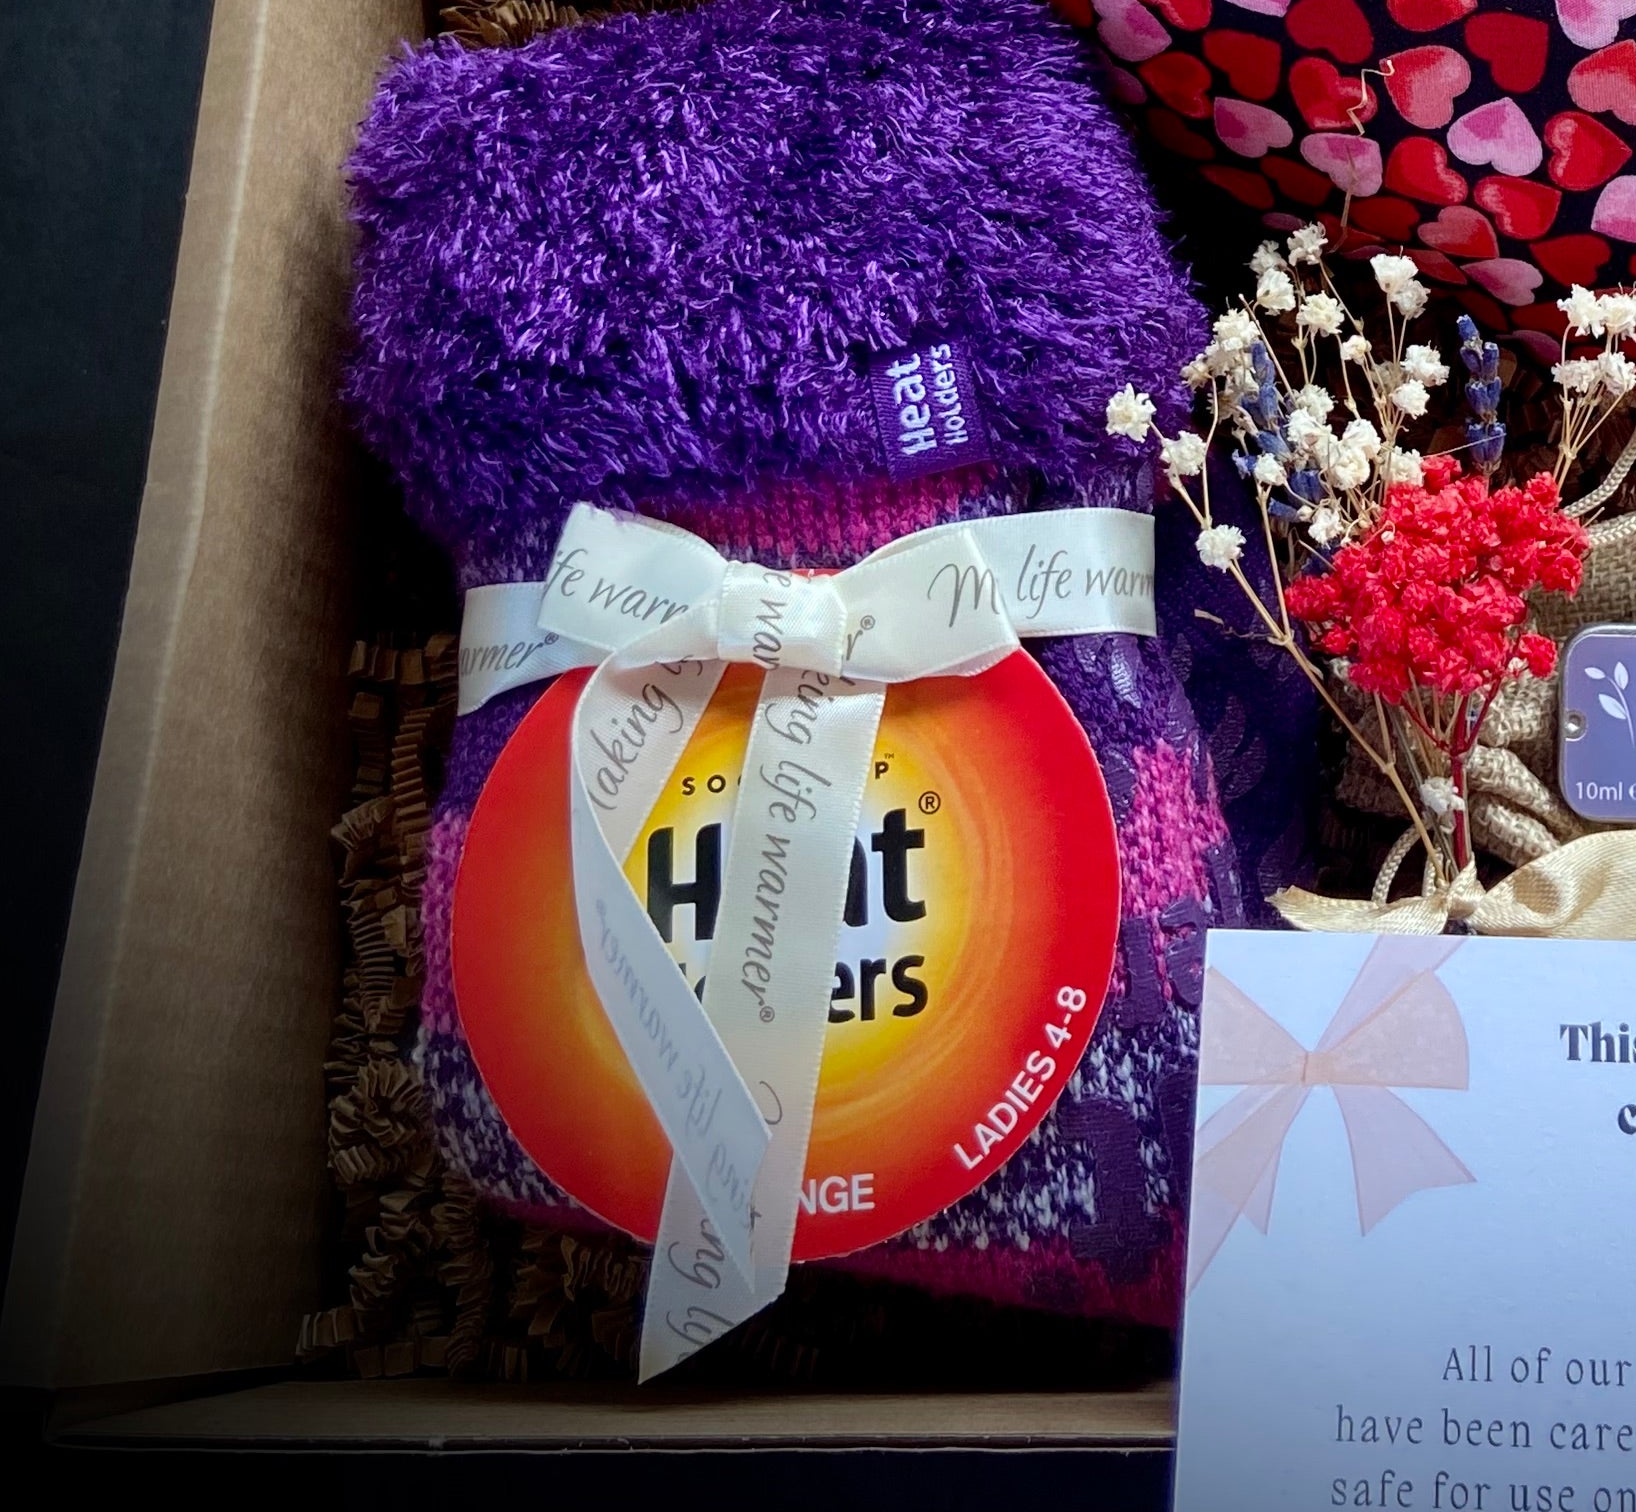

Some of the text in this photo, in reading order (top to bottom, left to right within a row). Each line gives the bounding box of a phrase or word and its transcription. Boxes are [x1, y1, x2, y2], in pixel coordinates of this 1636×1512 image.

[885, 353, 937, 455] Heat
[929, 344, 969, 445] Holders
[1017, 544, 1072, 619] life
[588, 683, 684, 810] aking
[760, 760, 832, 823] life
[1575, 781, 1623, 801] 10ml
[954, 985, 1087, 1170] LADIES 4-8
[799, 1173, 875, 1216] NGE
[1442, 1344, 1493, 1382] All
[1510, 1347, 1552, 1384] of
[1565, 1358, 1633, 1387] our
[1335, 1404, 1423, 1444] have
[1441, 1408, 1532, 1448] been
[1331, 1469, 1413, 1508] safe
[1432, 1470, 1492, 1511] for
[1509, 1484, 1575, 1512] use
[1593, 1487, 1636, 1512] on
